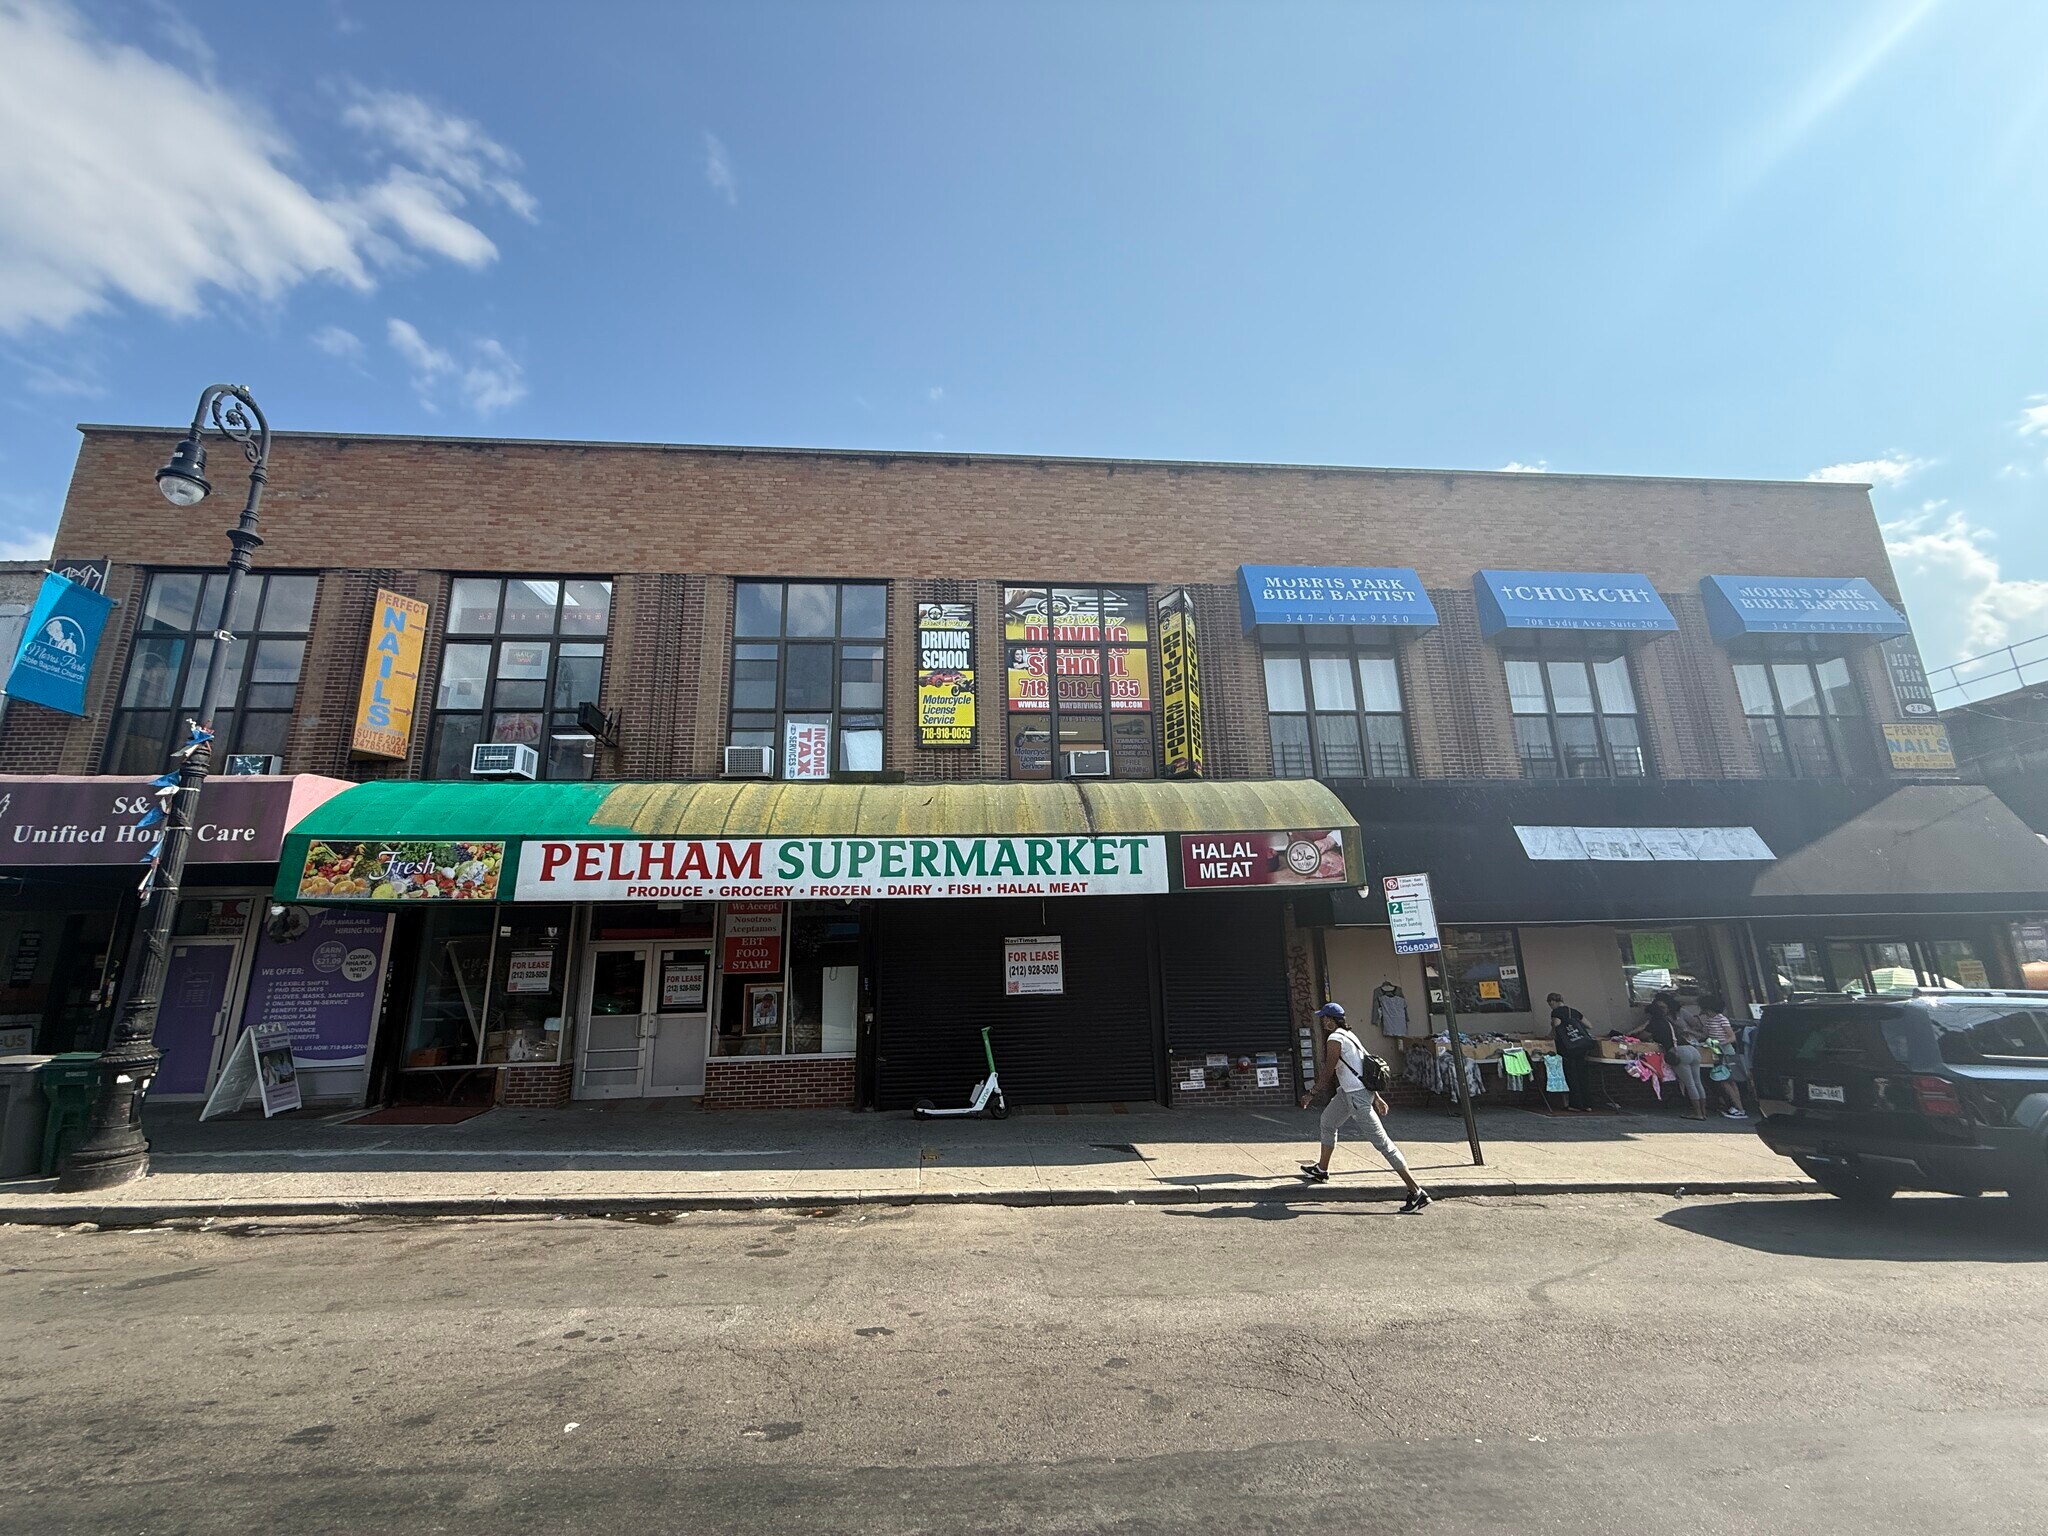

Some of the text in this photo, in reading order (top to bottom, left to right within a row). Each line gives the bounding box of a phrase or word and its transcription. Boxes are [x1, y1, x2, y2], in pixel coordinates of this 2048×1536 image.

[1264, 576, 1405, 590] MORRIS PARK
[1262, 589, 1416, 602] BIBLE BAPTIST
[1514, 586, 1640, 603] CHURCH
[1739, 586, 1866, 600] MORRIS PARK
[378, 591, 427, 616] PERFECT
[1739, 599, 1881, 612] BIBLE BAPTIST
[1286, 614, 1409, 624] 347-674-9550
[1525, 618, 1544, 626] 708
[1548, 618, 1578, 629] Lydig
[1610, 620, 1637, 628] Suite
[921, 631, 970, 649] DRIVING
[922, 650, 970, 669] SCHOOL
[21, 654, 39, 666] Bible
[61, 668, 85, 681] Church
[367, 606, 407, 727] NAILS
[922, 695, 972, 706] Motorcycle
[1162, 630, 1186, 758] DRIVING SCHOOL
[922, 705, 956, 714] License
[922, 714, 955, 724] Service
[921, 727, 972, 739] 718-918-0035
[1894, 725, 1935, 736] PERFECT
[356, 728, 384, 742] SUITE
[385, 734, 406, 747] 202A
[788, 735, 798, 767] SERVICES
[1887, 736, 1949, 753] NAILS
[797, 728, 812, 776] TAX
[813, 728, 826, 776] INCOME
[13, 824, 105, 843] Unified
[197, 824, 255, 843] Care
[1191, 841, 1258, 860] HALAL
[1292, 848, 1315, 862] حلال
[368, 849, 437, 880] Fresh
[540, 837, 1149, 882] PELHAM SUPERMARKET
[1199, 861, 1253, 879] MEAT
[627, 882, 1089, 898] PRODUCE GROCERY FROZEN DAIRY FISH HALAL MEAT
[746, 902, 778, 911] Accept
[1391, 903, 1400, 914] 2
[337, 918, 370, 926] AVAILABLE
[335, 926, 384, 935] HIRING NOW
[741, 937, 765, 946] EBT
[1397, 943, 1429, 952] 206803
[320, 946, 342, 954] EARN
[736, 949, 769, 958] FOOD
[1008, 951, 1060, 962] FOR LEASE
[528, 961, 550, 969] LEASE
[732, 960, 772, 969] STAMP
[1009, 964, 1059, 978] (212) 928-5050
[262, 967, 305, 976] WE OFFER:
[511, 971, 525, 980] (212)
[666, 985, 679, 993] (212)
